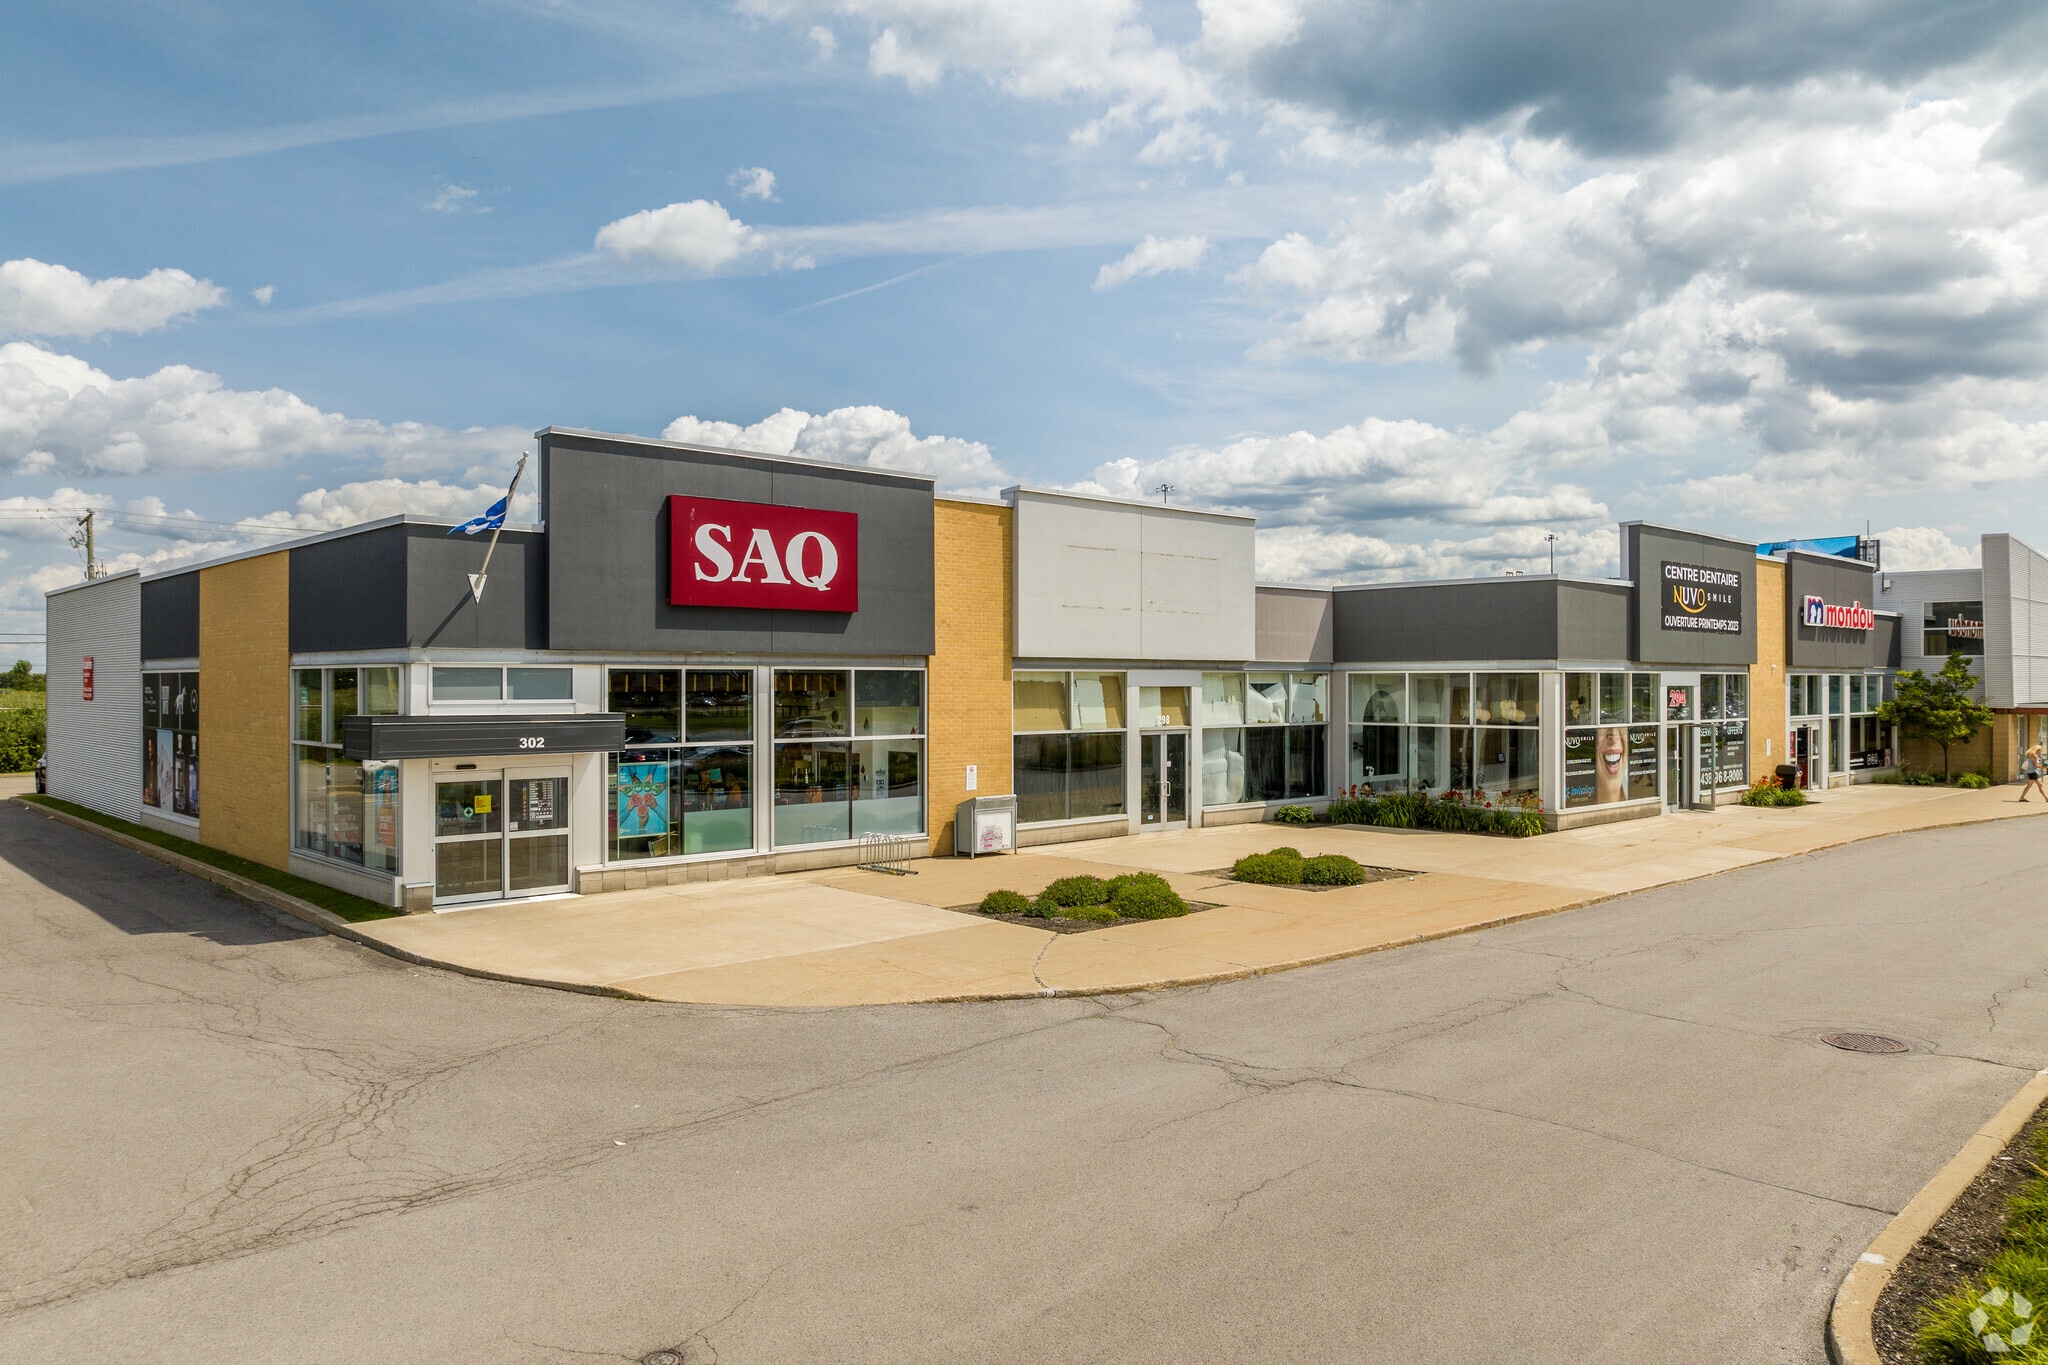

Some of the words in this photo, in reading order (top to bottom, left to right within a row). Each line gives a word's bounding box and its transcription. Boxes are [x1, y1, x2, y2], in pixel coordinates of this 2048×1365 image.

[694, 523, 839, 592] SAQ
[1665, 565, 1698, 582] CENTRE
[1700, 569, 1738, 587] DENTAIRE
[1707, 592, 1731, 603] SMILE
[1664, 615, 1698, 628] OUVERTURE
[1699, 617, 1727, 632] PRINTEMPS
[1826, 601, 1873, 630] mondou
[1669, 689, 1686, 706] 294
[1157, 714, 1170, 725] 298
[519, 737, 545, 749] 302
